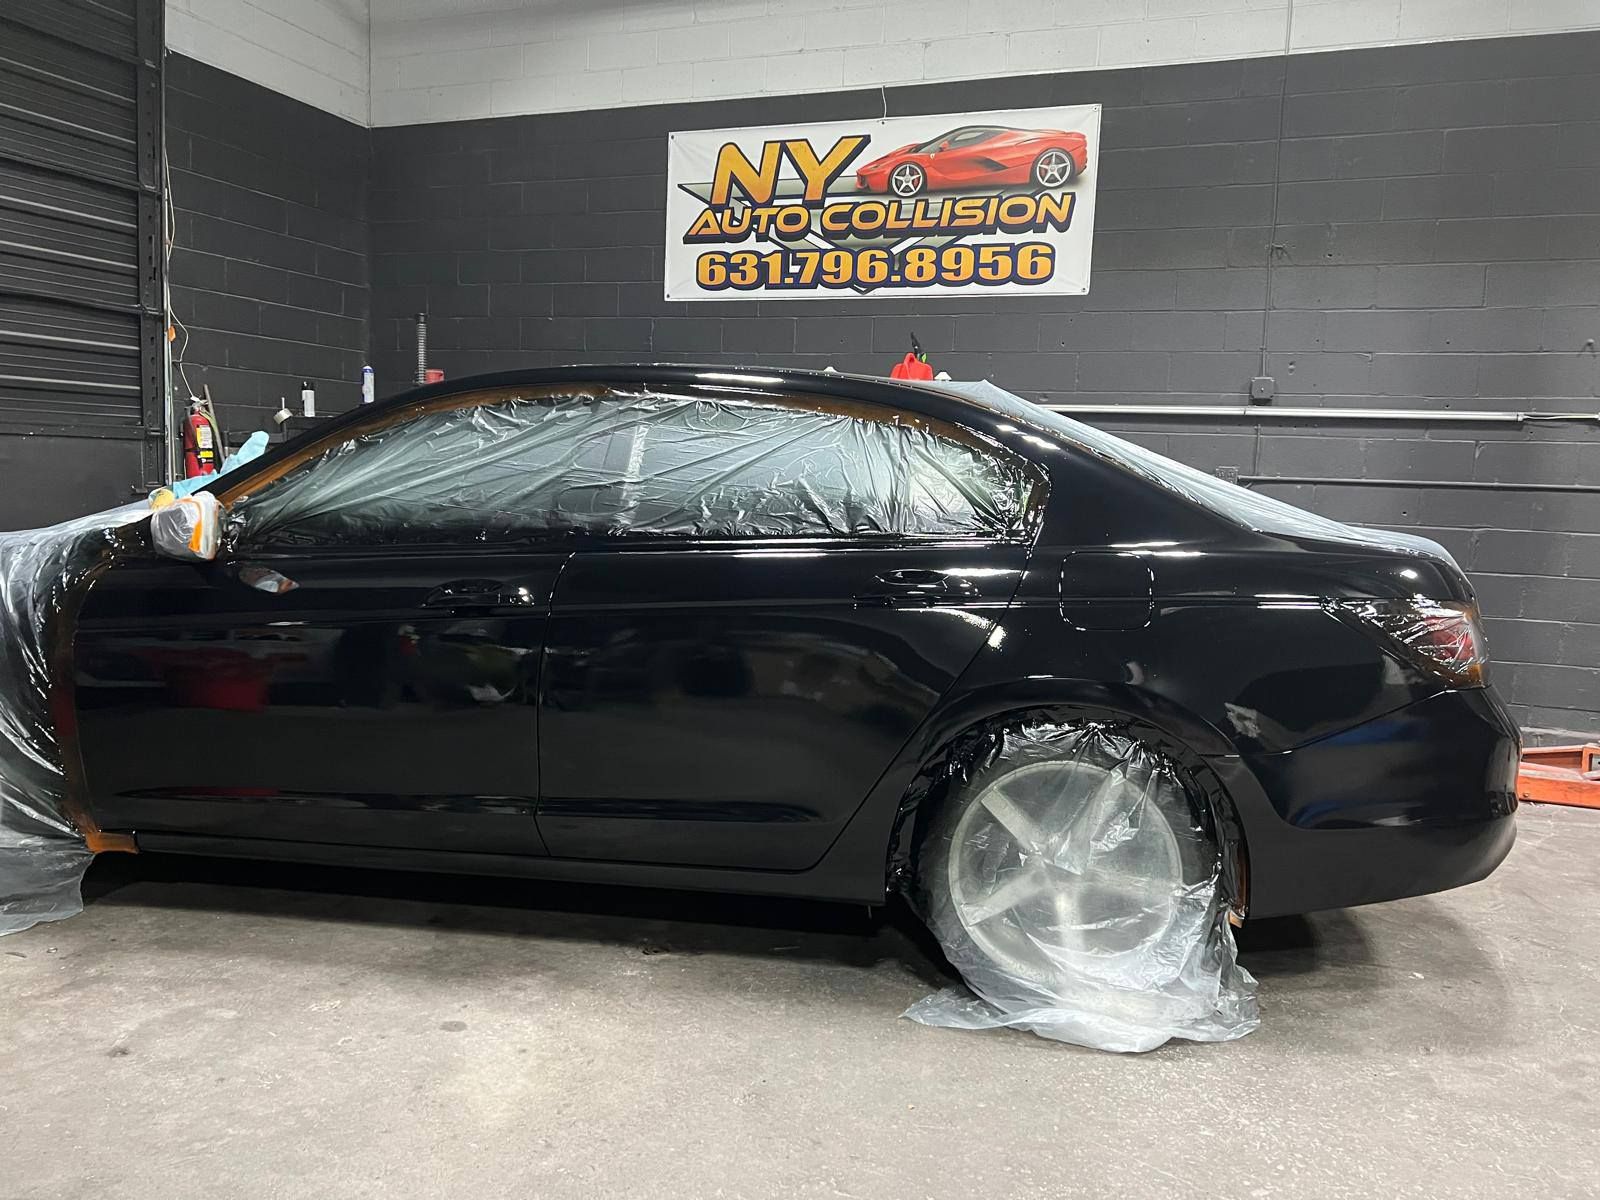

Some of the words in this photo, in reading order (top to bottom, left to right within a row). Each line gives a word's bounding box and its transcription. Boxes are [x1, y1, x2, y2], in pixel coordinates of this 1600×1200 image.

[711, 136, 870, 206] NY
[685, 203, 809, 242] AUTO
[820, 193, 1076, 239] COLLISION
[696, 242, 1056, 289] 631.796.8956
